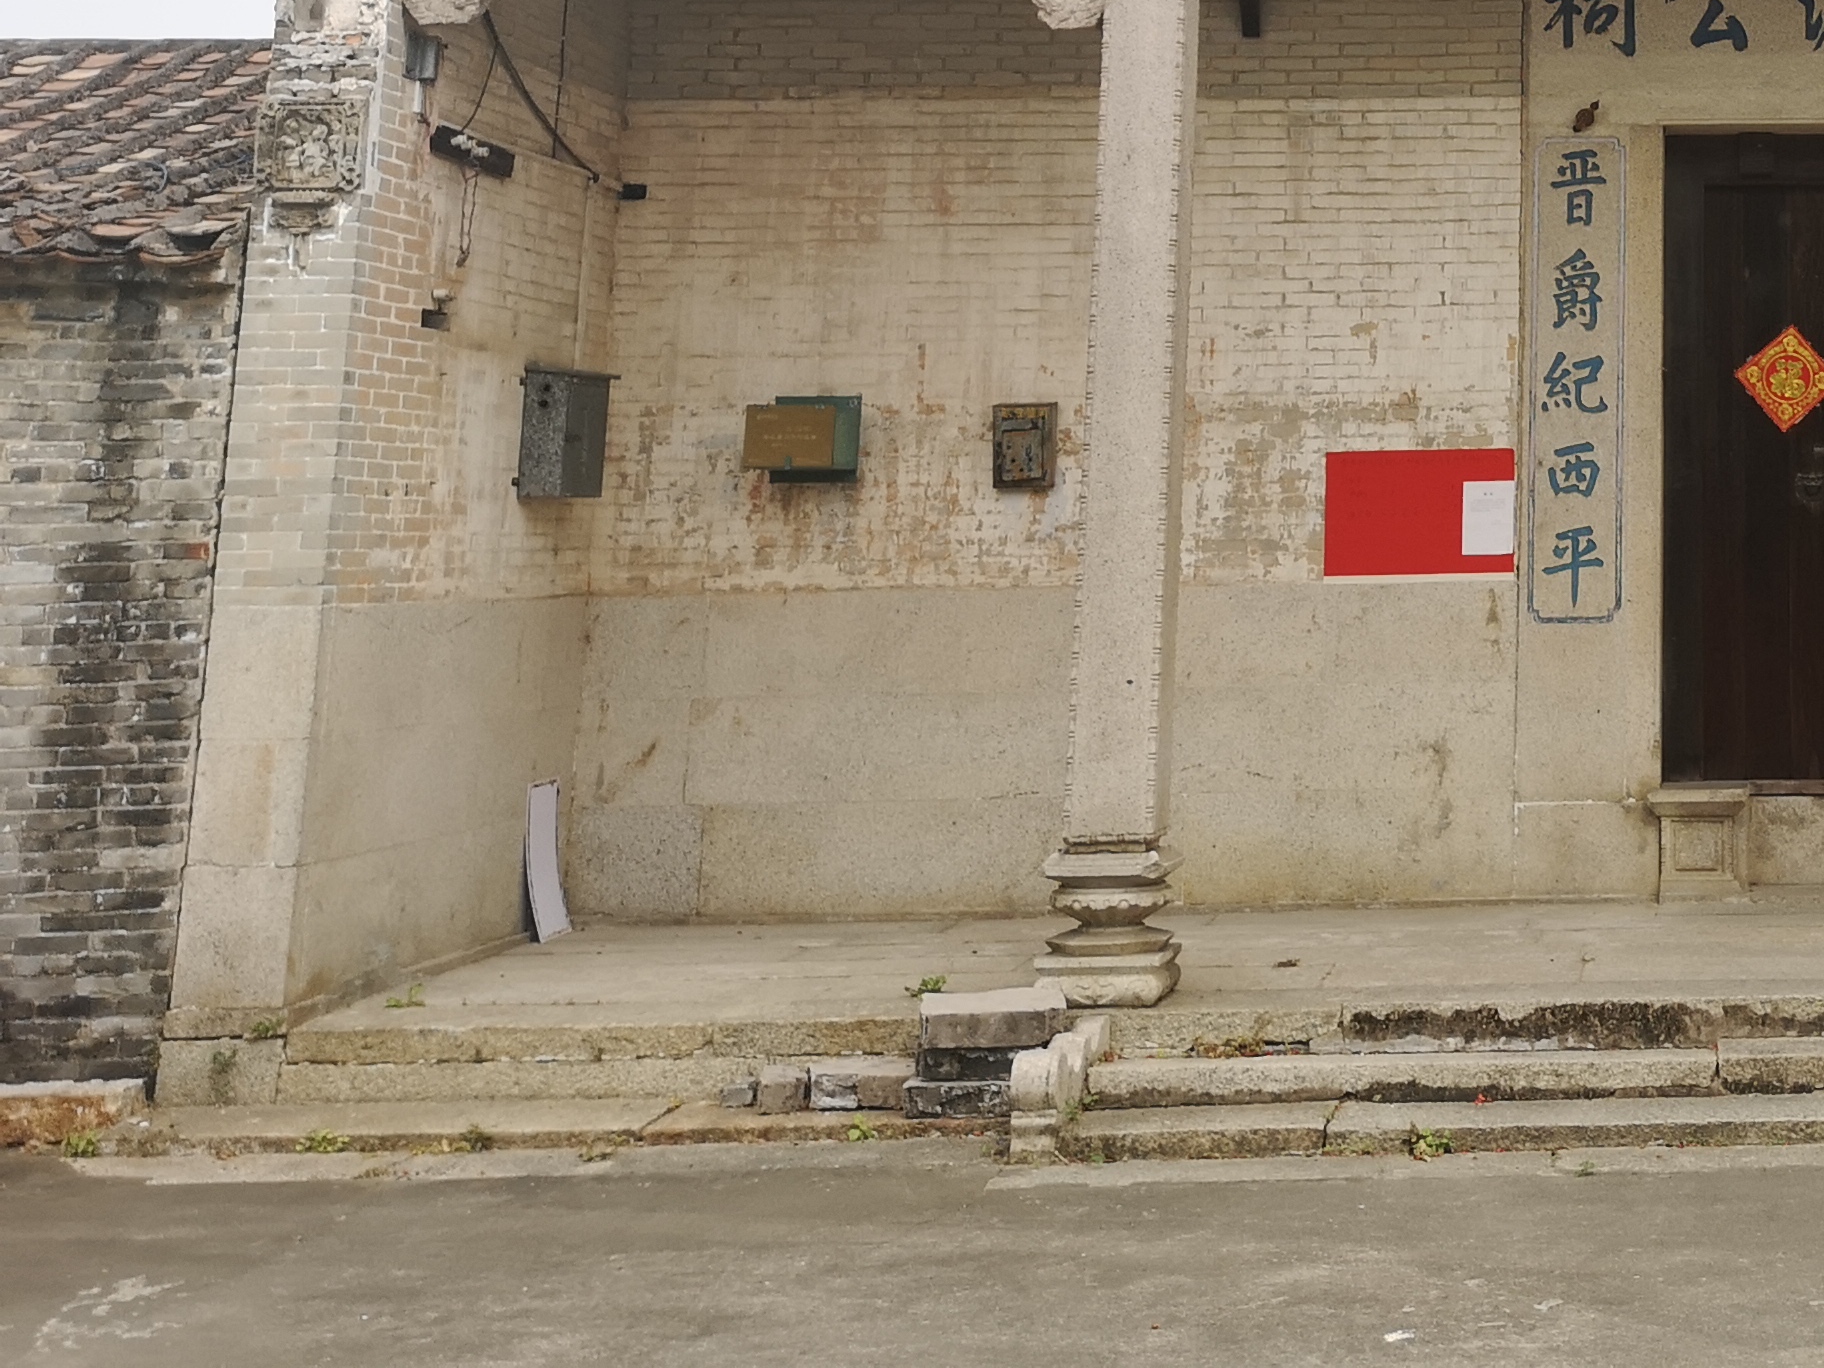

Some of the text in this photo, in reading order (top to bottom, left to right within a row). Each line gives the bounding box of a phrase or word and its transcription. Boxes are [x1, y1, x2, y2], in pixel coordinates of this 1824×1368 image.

[1541, 147, 1609, 609] 晋爵紀西平
[1770, 359, 1806, 398] 福
